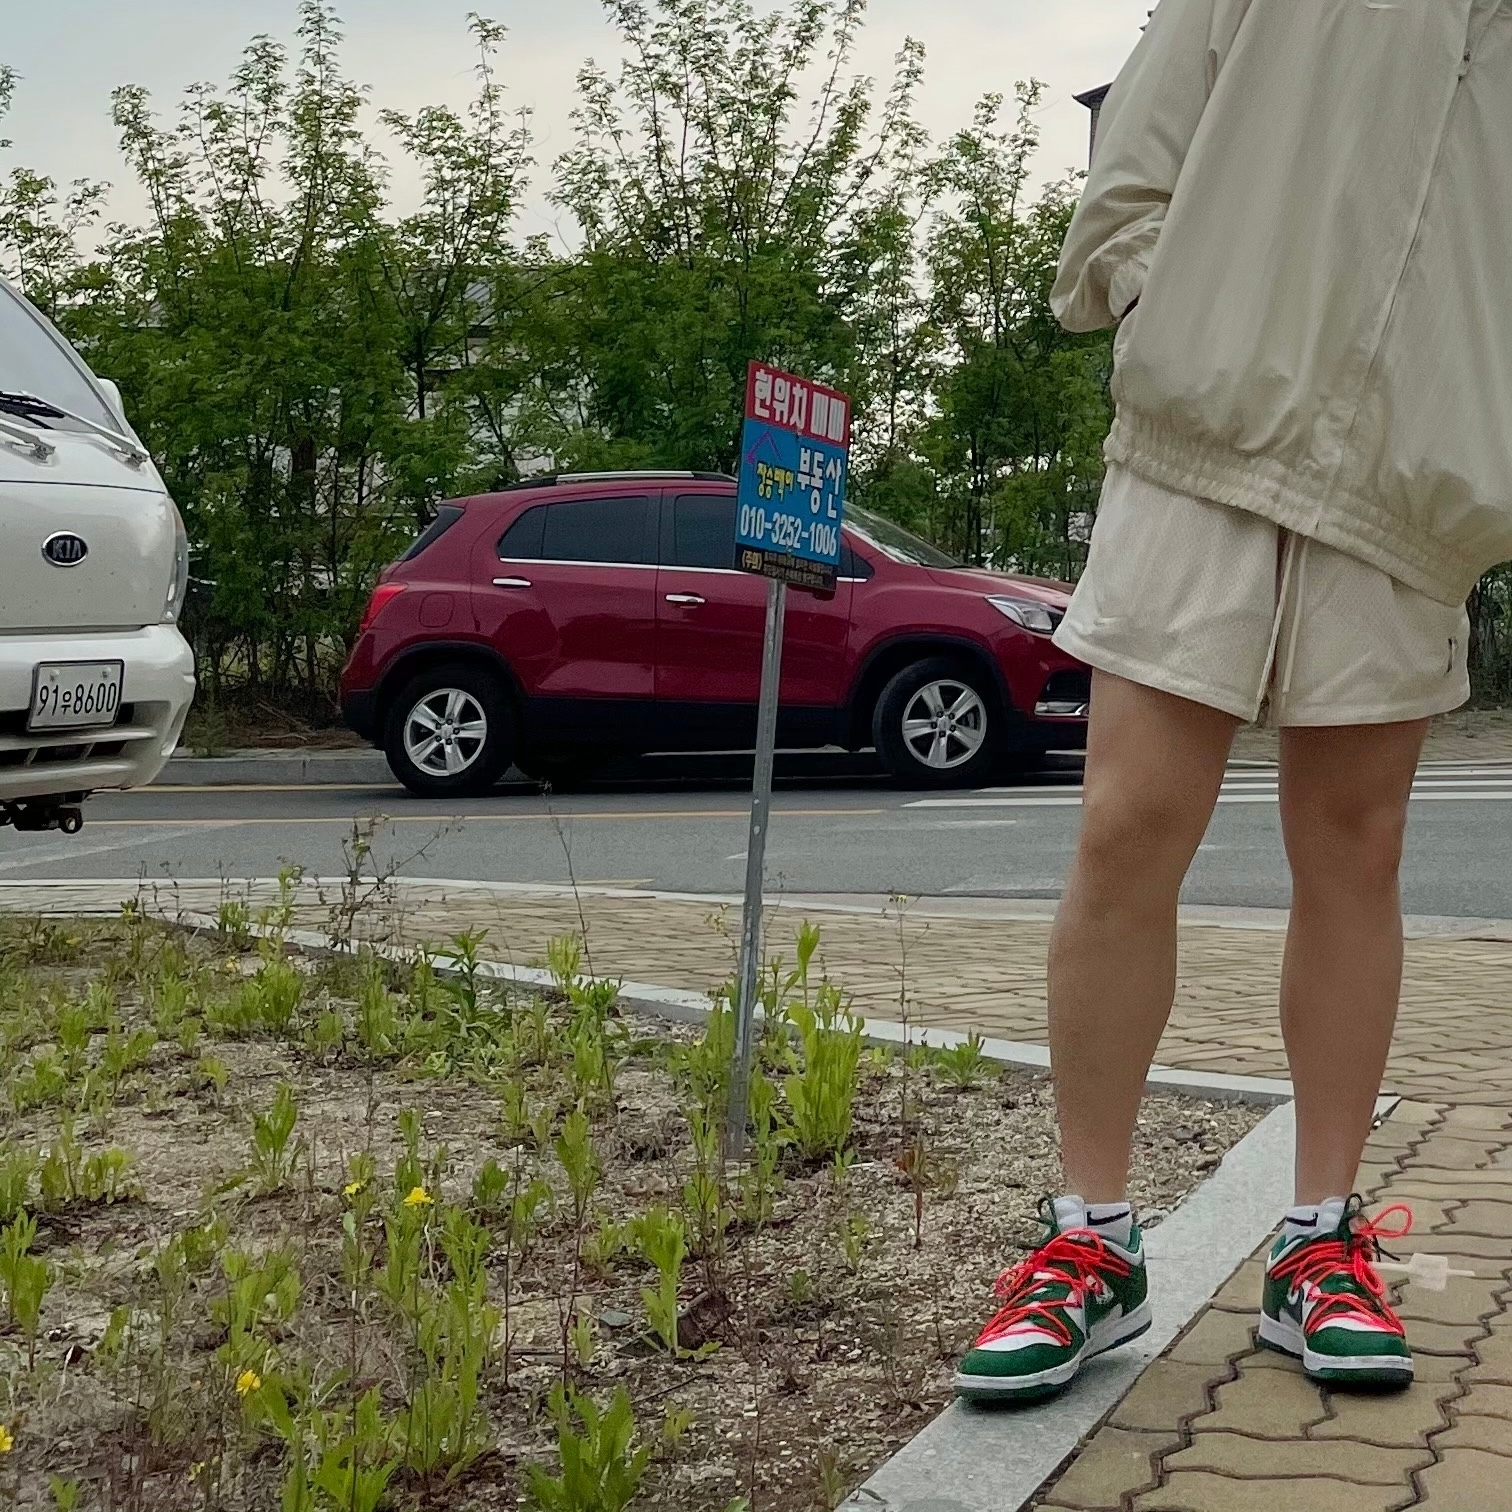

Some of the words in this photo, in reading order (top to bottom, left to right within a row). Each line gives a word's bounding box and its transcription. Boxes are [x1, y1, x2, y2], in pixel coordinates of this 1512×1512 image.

[754, 368, 808, 430] 현위치
[810, 391, 846, 443] 매매
[797, 447, 842, 519] 부동산
[52, 539, 82, 559] KIA
[739, 503, 838, 557] 010-3252-1006
[36, 682, 117, 716] 91우8600
